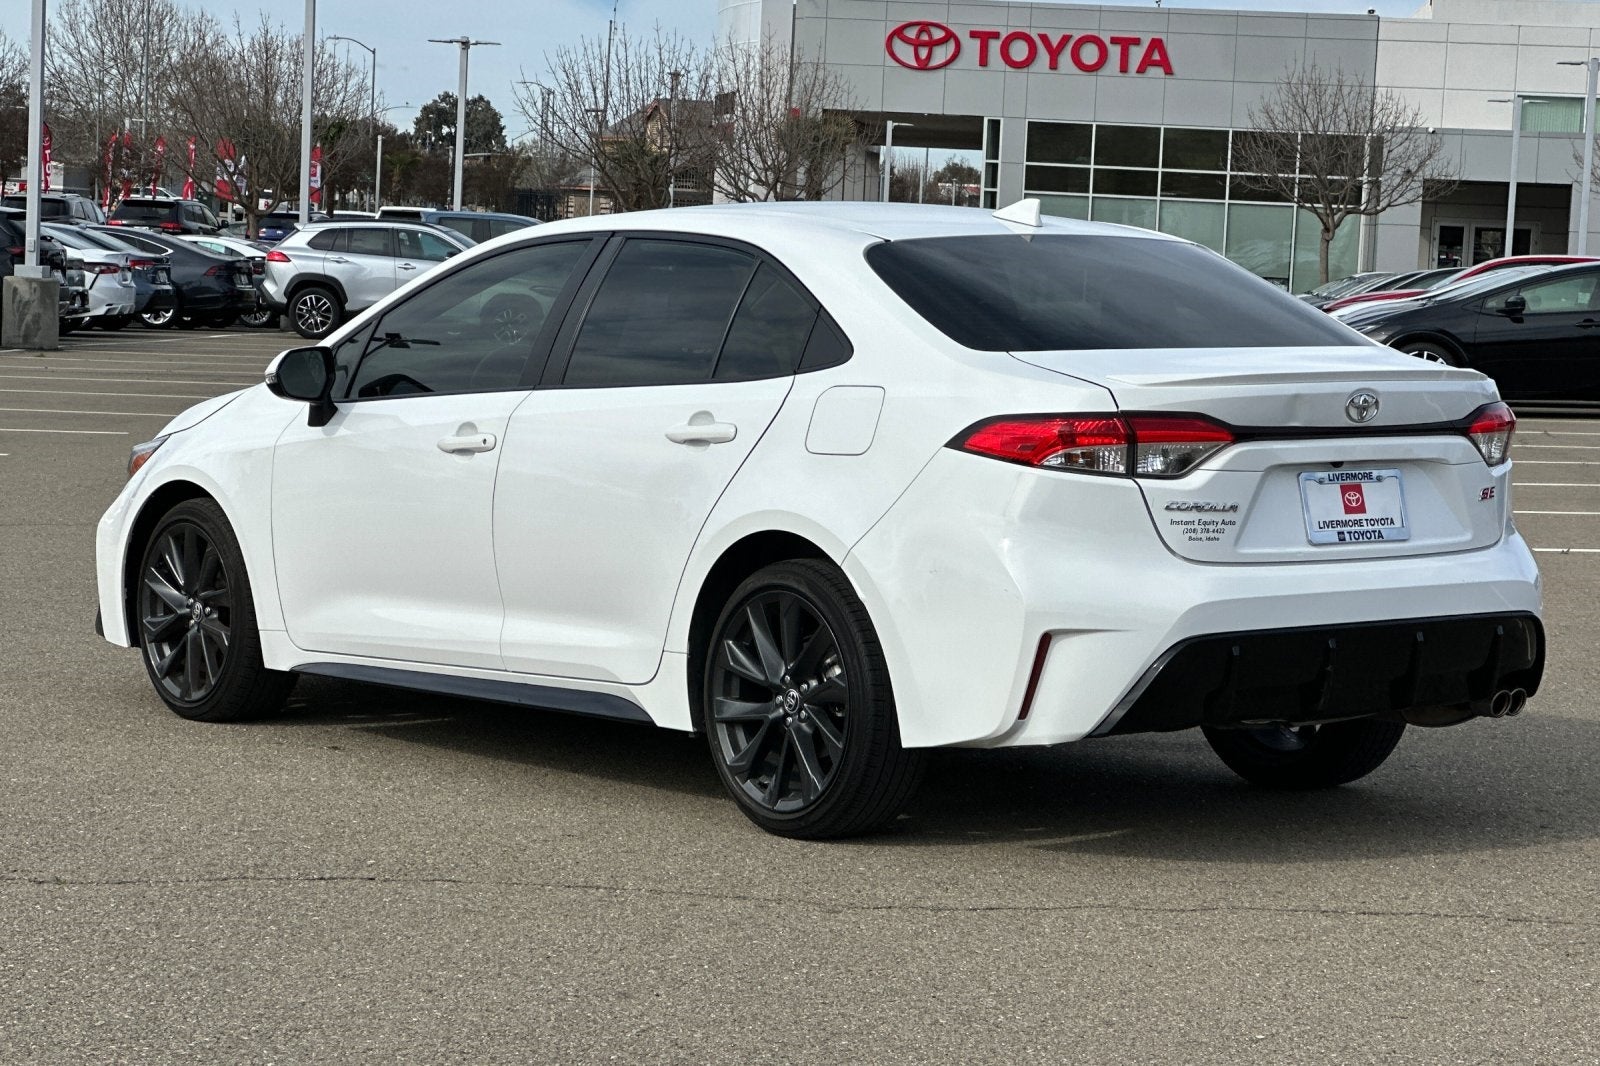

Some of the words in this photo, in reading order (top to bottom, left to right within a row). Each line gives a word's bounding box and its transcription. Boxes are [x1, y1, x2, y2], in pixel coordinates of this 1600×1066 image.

[969, 30, 1174, 75] TOYOTA
[1328, 472, 1374, 482] LIVERMORE
[1478, 486, 1496, 500] SE
[1164, 502, 1239, 512] COROLLA
[1170, 518, 1196, 526] Instant
[1197, 518, 1219, 527] Equity
[1220, 518, 1236, 526] Auto
[1318, 519, 1364, 530] LIVERMORE
[1365, 517, 1395, 527] TOYOTA
[1346, 530, 1385, 541] TOYOTA
